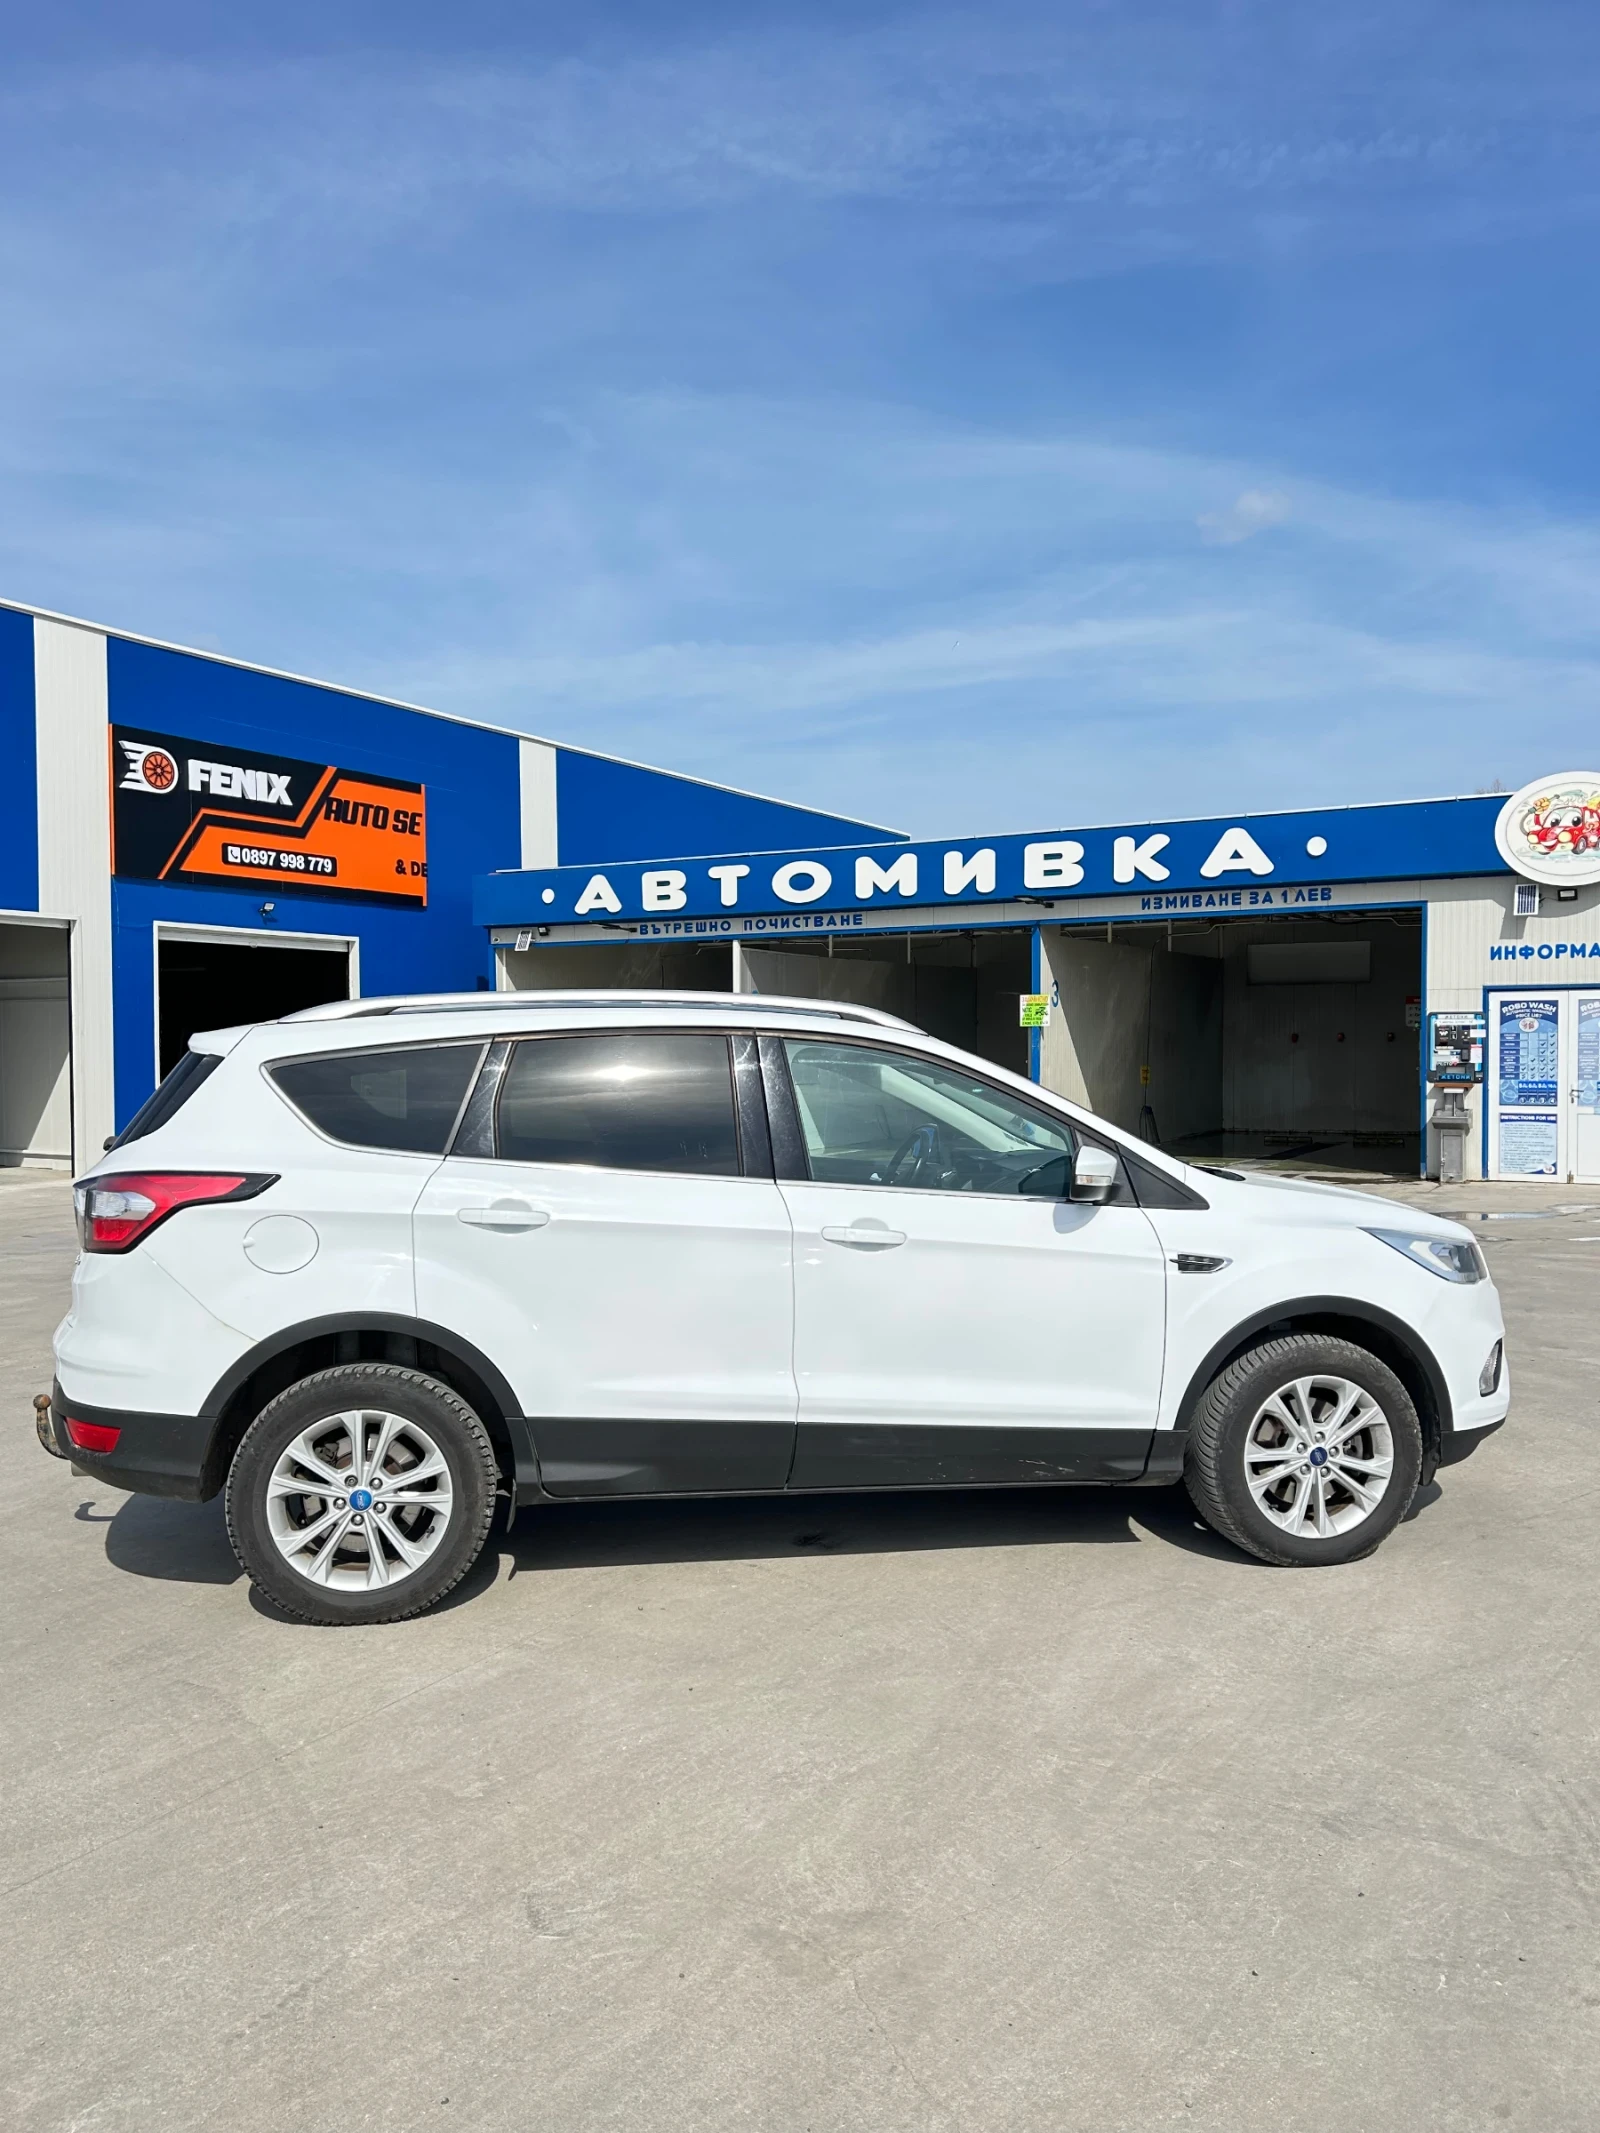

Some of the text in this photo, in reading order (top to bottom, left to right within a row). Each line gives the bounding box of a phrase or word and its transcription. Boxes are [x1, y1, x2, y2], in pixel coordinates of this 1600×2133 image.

[187, 758, 293, 806] FENIX
[324, 797, 423, 836] AUTO SE
[241, 848, 333, 873] 0897 998 779
[395, 859, 428, 878] & DE
[574, 827, 1275, 915] АВТОМИВКА
[1141, 887, 1332, 911] ИЗМИВАНЕ ЗА 1 ЛЕВ
[639, 913, 863, 936] ВЪТРЕШНО ПОЧИСТВАНЕ
[1489, 942, 1600, 961] ИНФОРМА
[1051, 979, 1059, 1008] 3
[1502, 1001, 1557, 1014] ROBO WASH
